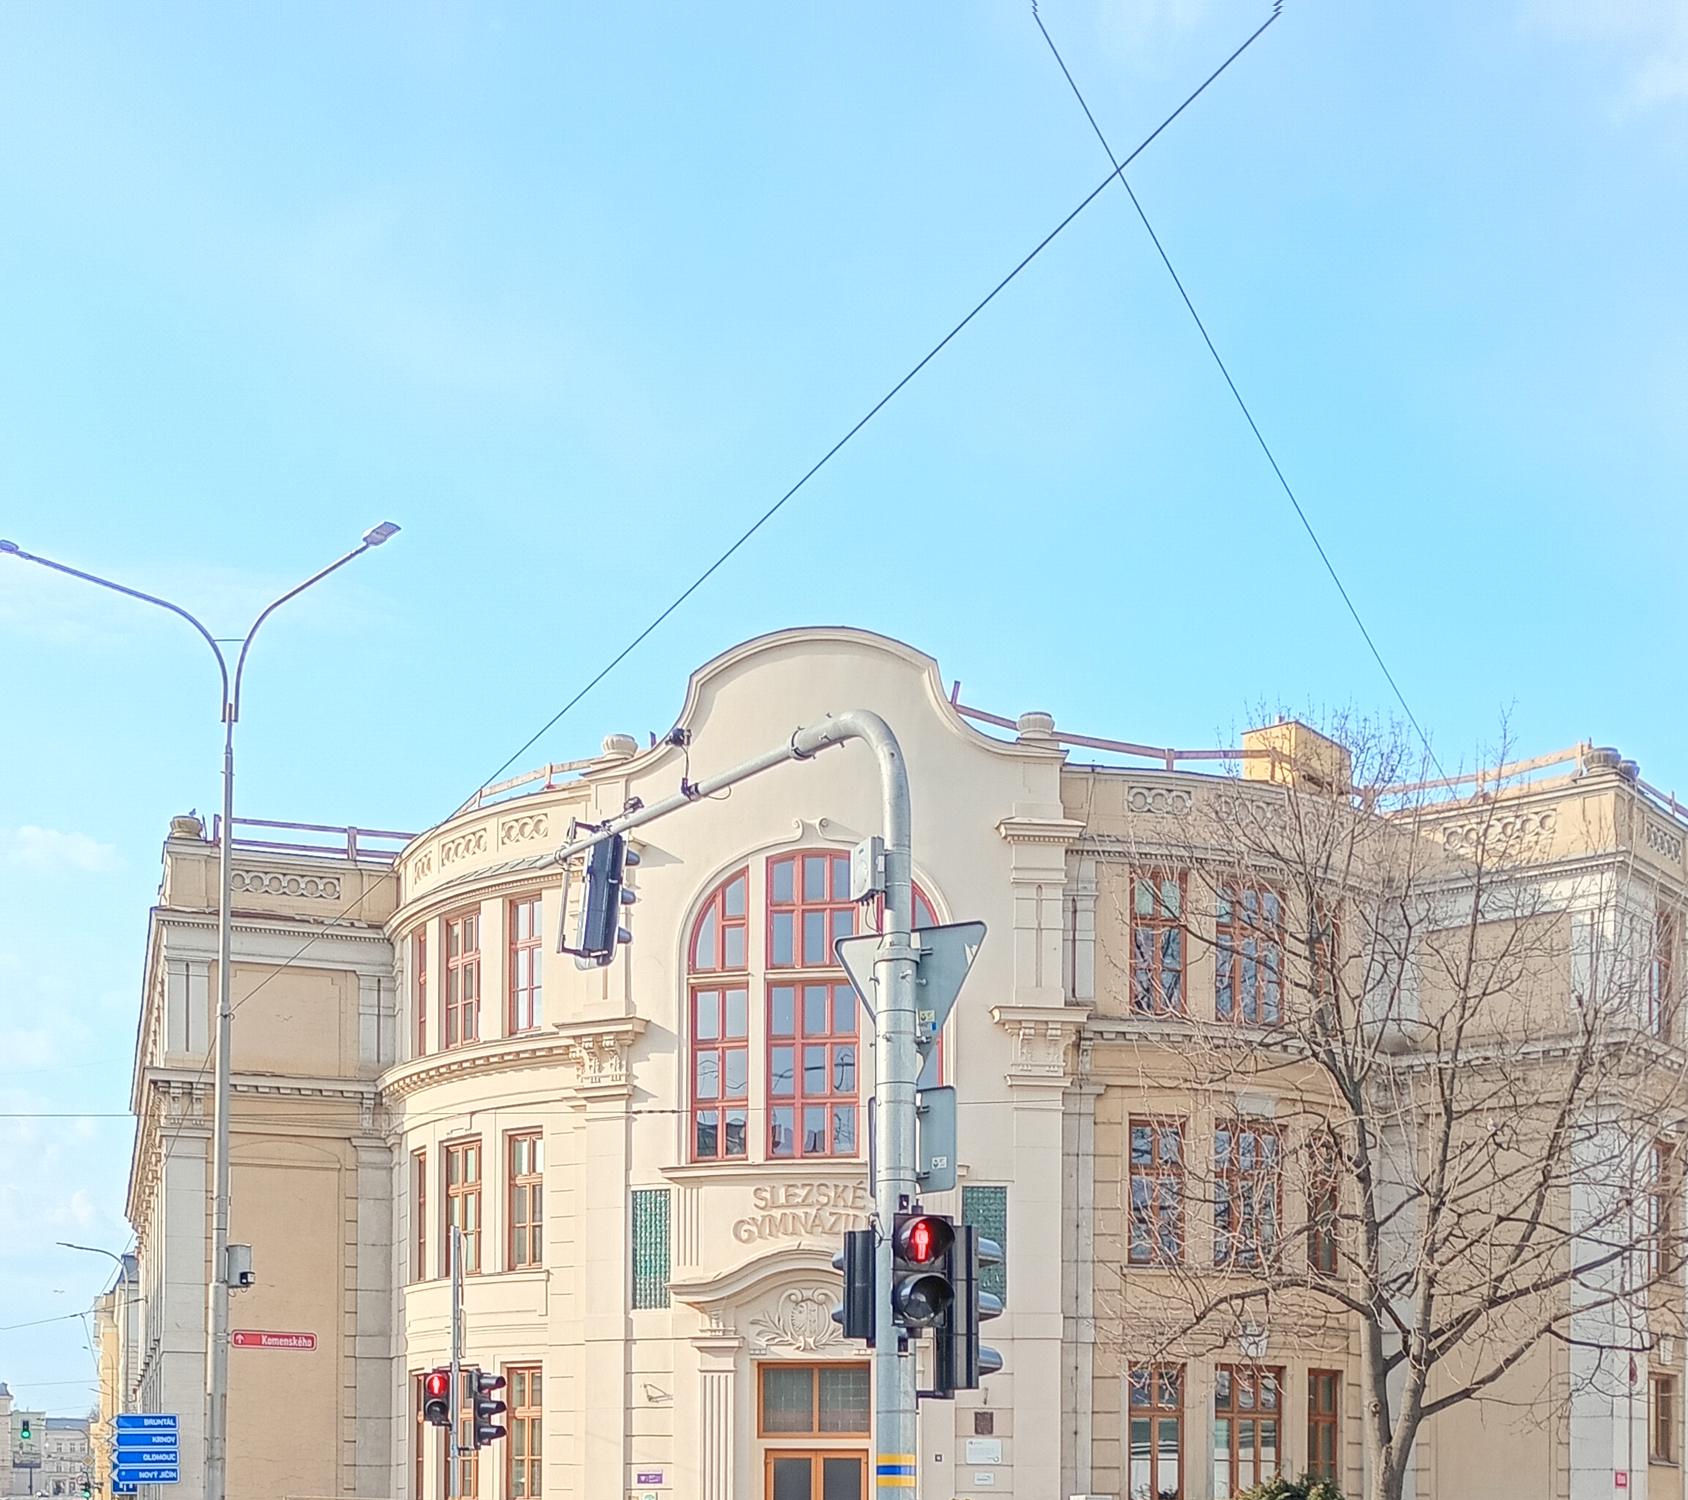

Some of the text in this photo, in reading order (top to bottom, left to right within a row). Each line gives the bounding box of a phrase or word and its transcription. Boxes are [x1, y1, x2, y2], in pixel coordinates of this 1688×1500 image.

[753, 1180, 868, 1210] SLEZSKÉ
[732, 1207, 870, 1244] GYMNÁZIU
[261, 1334, 313, 1347] Komenského
[142, 1453, 176, 1461] OLOMOUC
